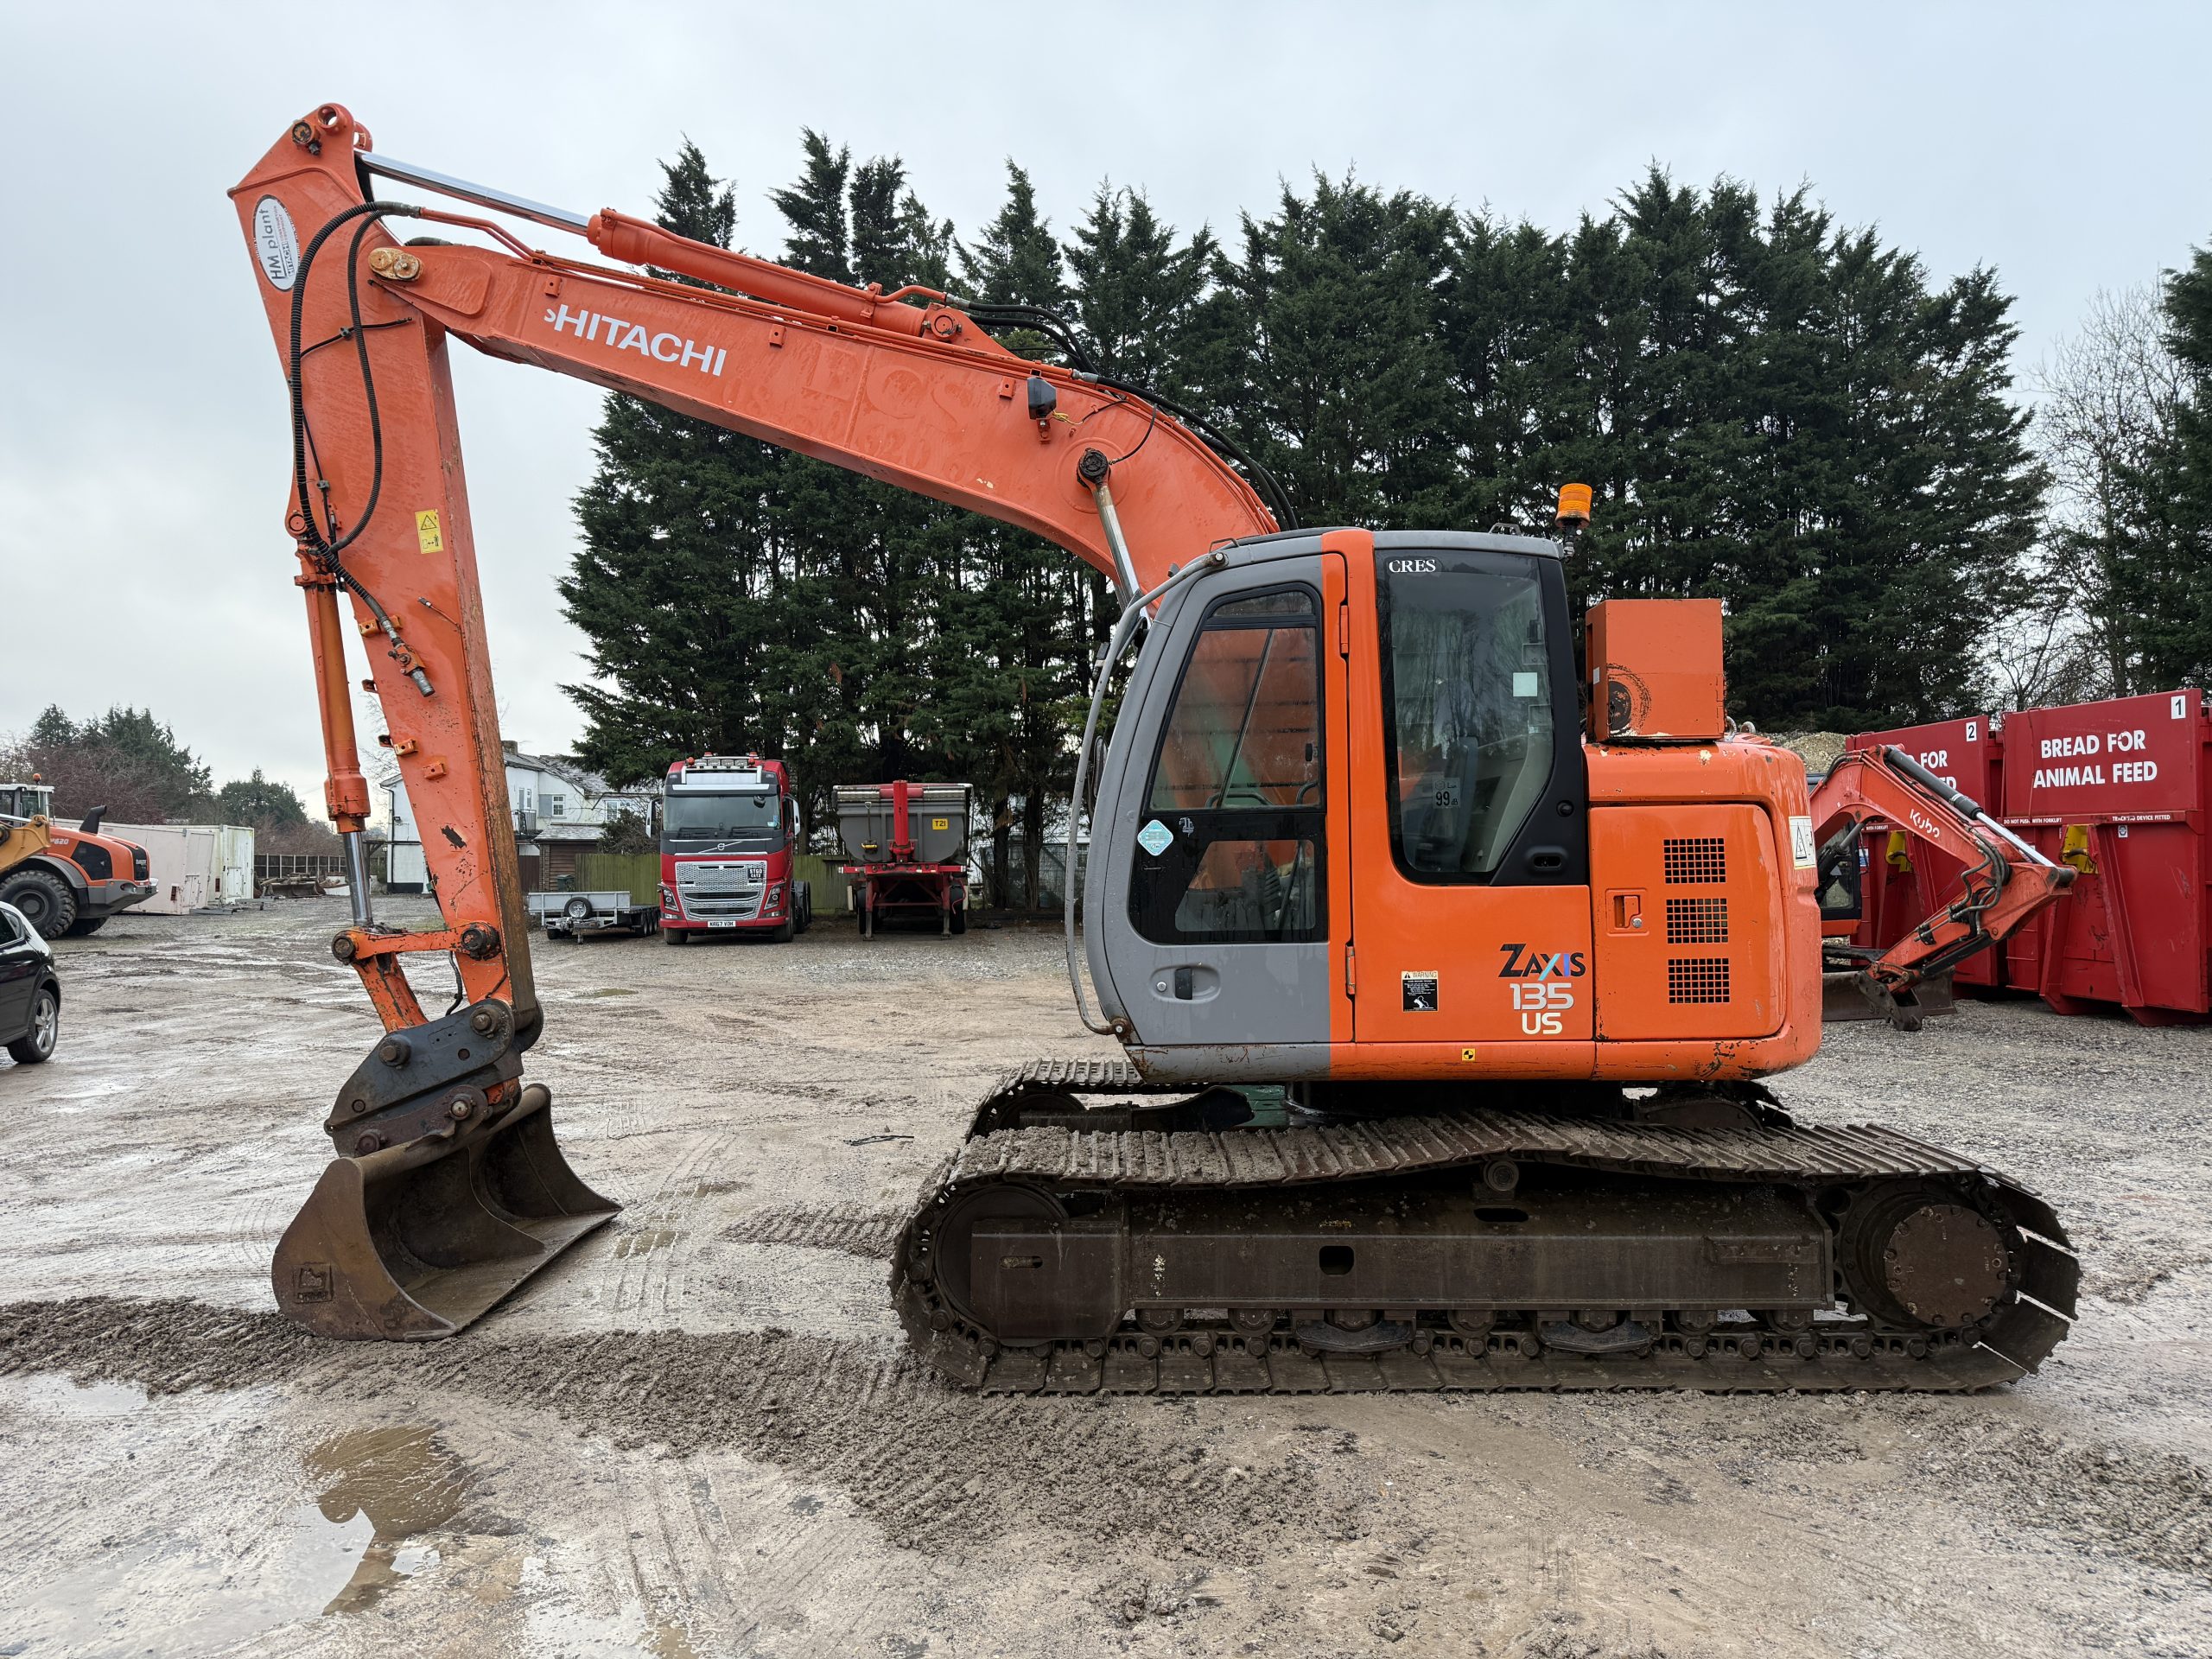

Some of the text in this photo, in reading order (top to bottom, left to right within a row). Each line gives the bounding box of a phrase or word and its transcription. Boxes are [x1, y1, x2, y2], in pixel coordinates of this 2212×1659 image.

[259, 208, 287, 279] HM plant
[282, 241, 295, 276] HITACHI
[554, 304, 727, 377] HITACHI
[1389, 559, 1436, 573] CRES
[2175, 699, 2183, 715] 1
[1967, 725, 1975, 739] 2
[2041, 730, 2145, 759] BREAD FOR
[1920, 750, 1948, 769] FOR
[2033, 761, 2158, 788] ANIMAL FEED
[1435, 791, 1450, 806] 99
[1498, 943, 1586, 981] ZAXIS
[1510, 982, 1574, 1010] 135
[1522, 1012, 1563, 1035] US
